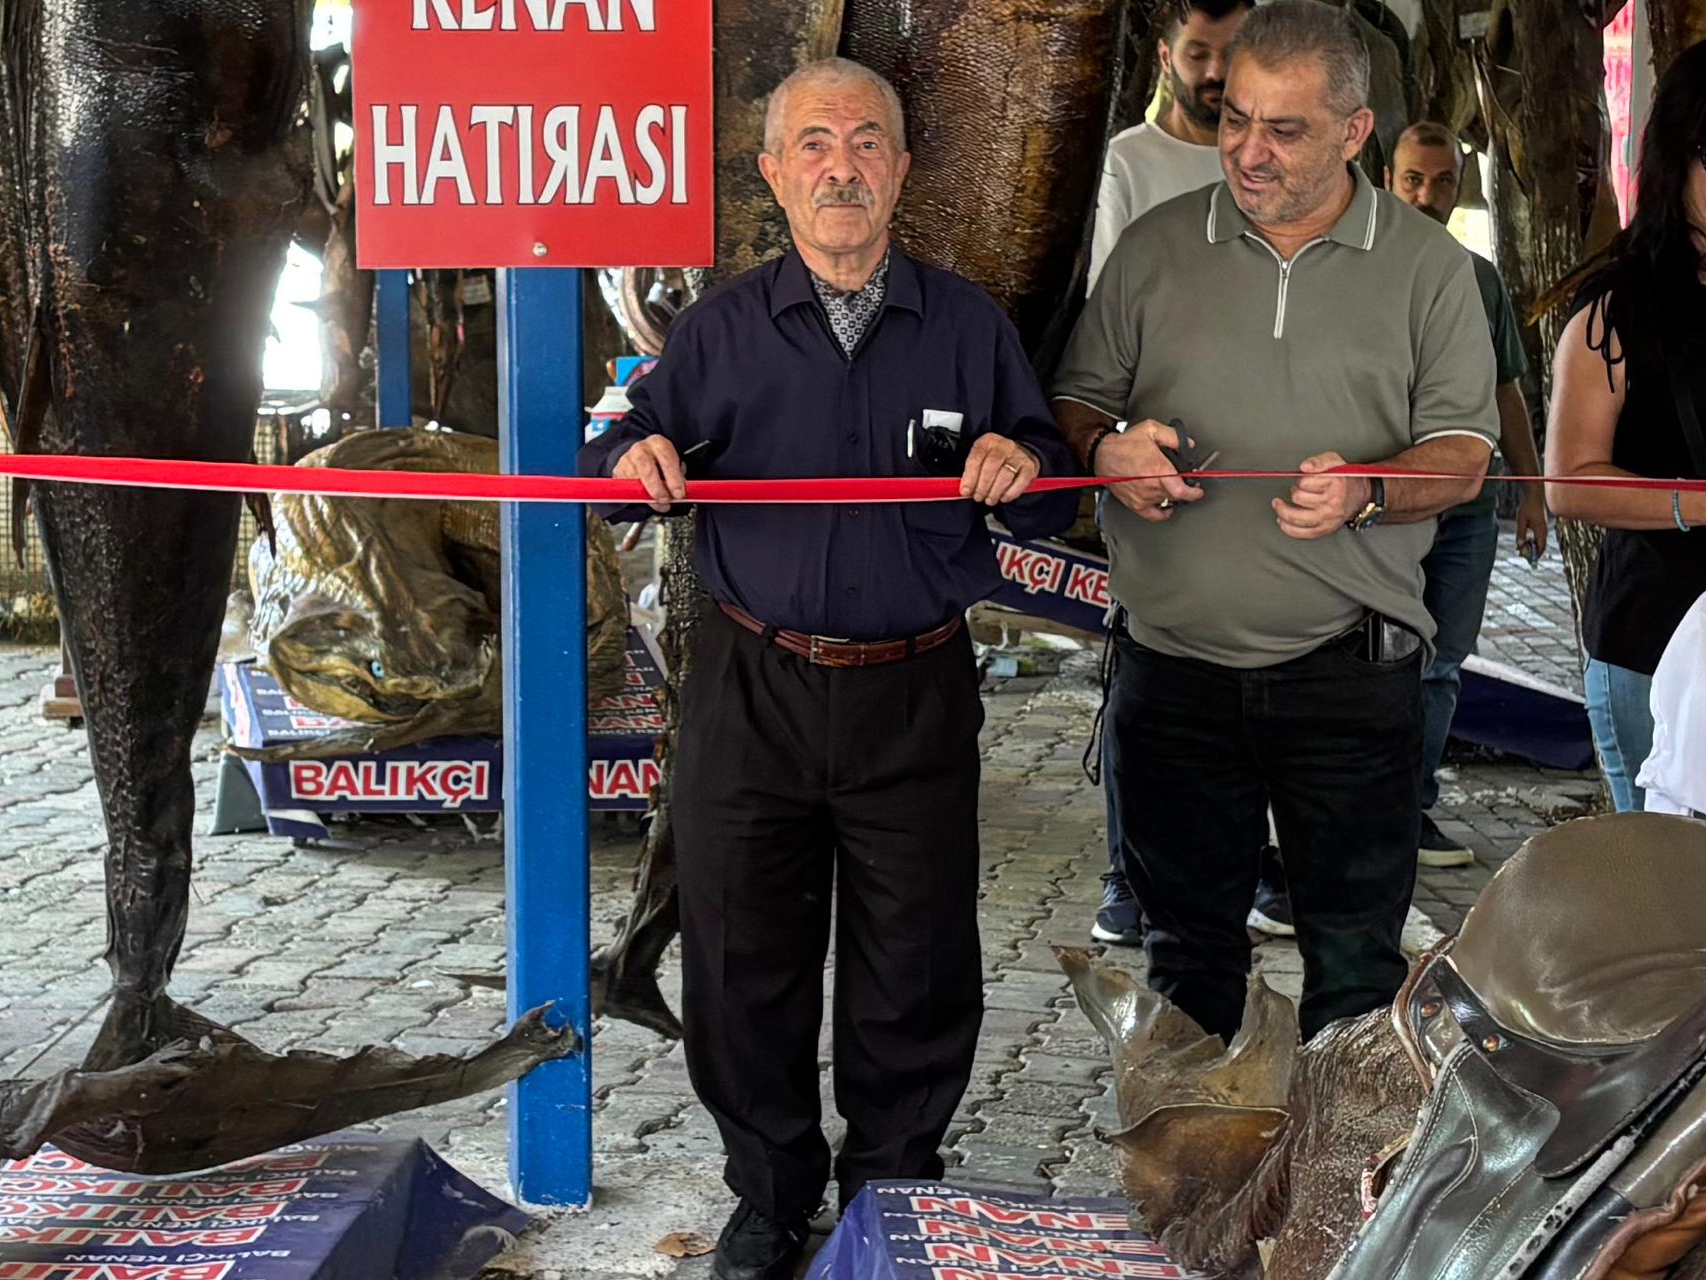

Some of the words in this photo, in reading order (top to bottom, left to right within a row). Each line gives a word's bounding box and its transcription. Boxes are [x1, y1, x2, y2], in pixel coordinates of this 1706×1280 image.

[288, 759, 490, 808] BALIKÇI
[908, 1195, 1131, 1231] ENAN
[924, 1242, 1184, 1278] ENAN
